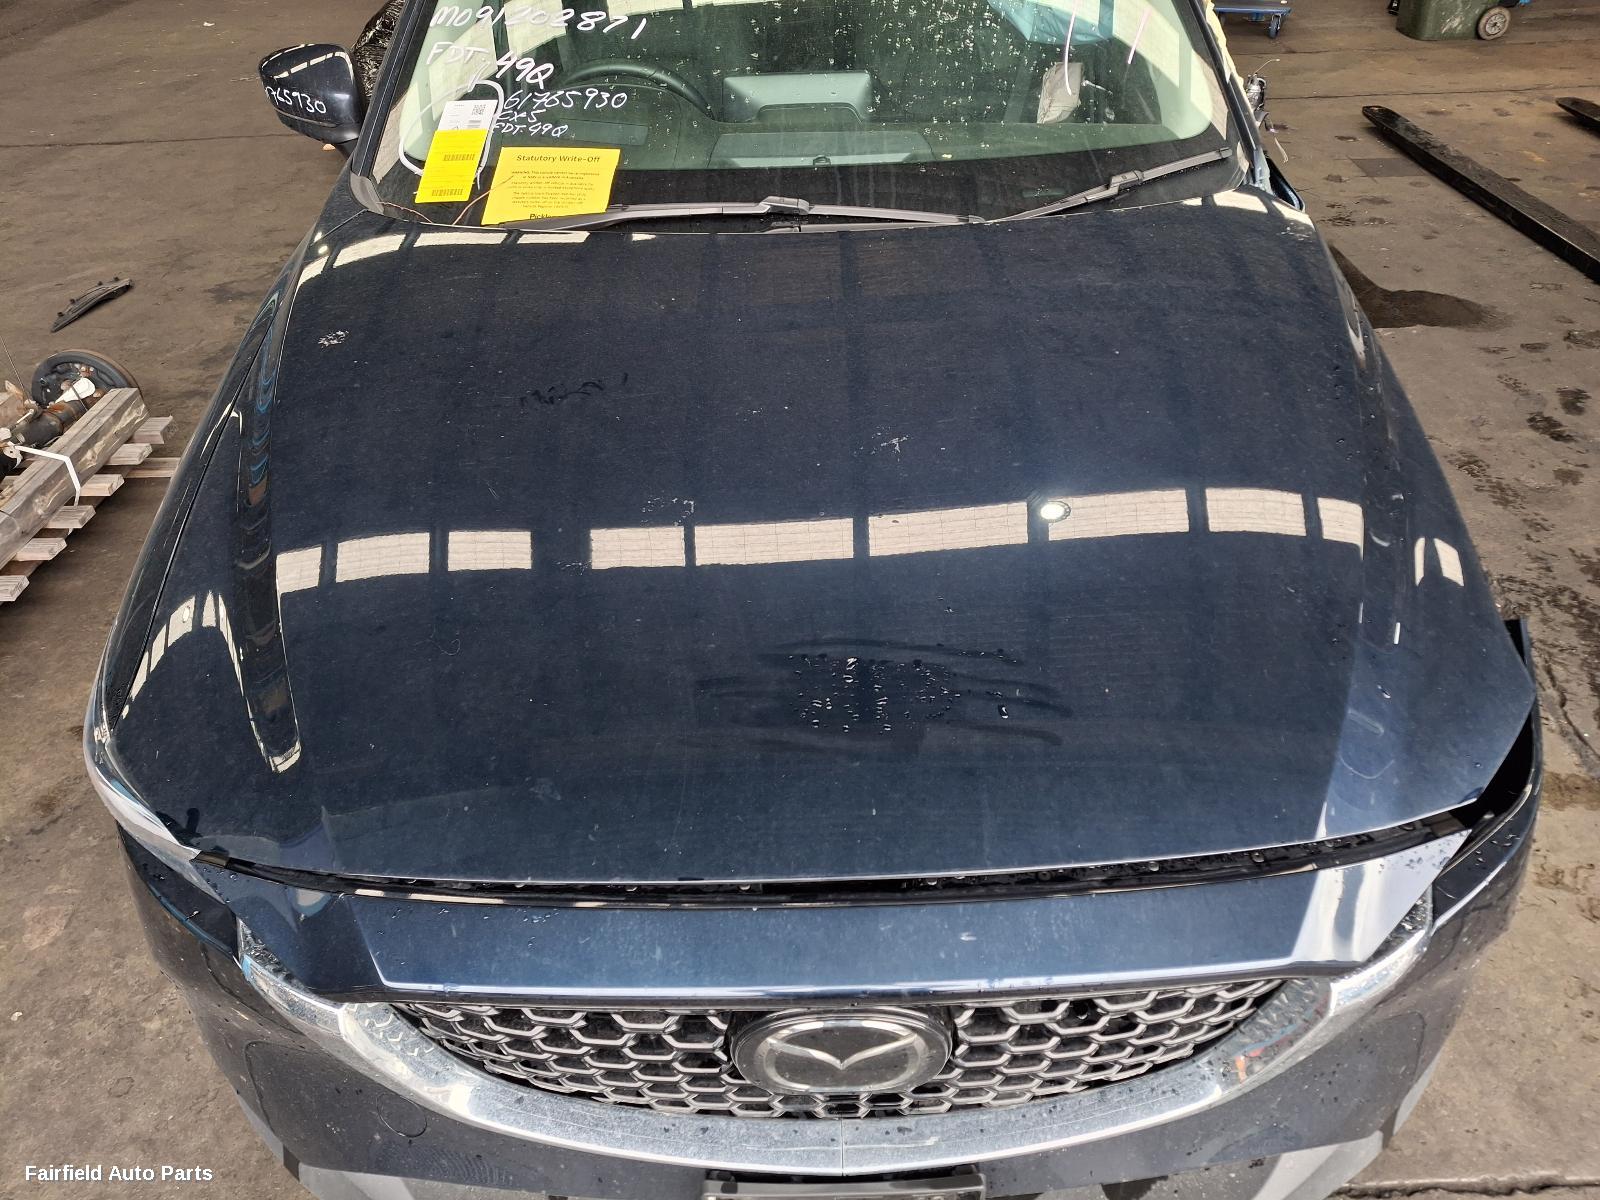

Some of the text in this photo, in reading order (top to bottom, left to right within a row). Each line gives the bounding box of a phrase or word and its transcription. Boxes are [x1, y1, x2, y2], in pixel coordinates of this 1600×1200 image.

[495, 50, 554, 89] 49Q
[504, 88, 628, 110] 61765930
[516, 154, 601, 163] Statutory Write-Off
